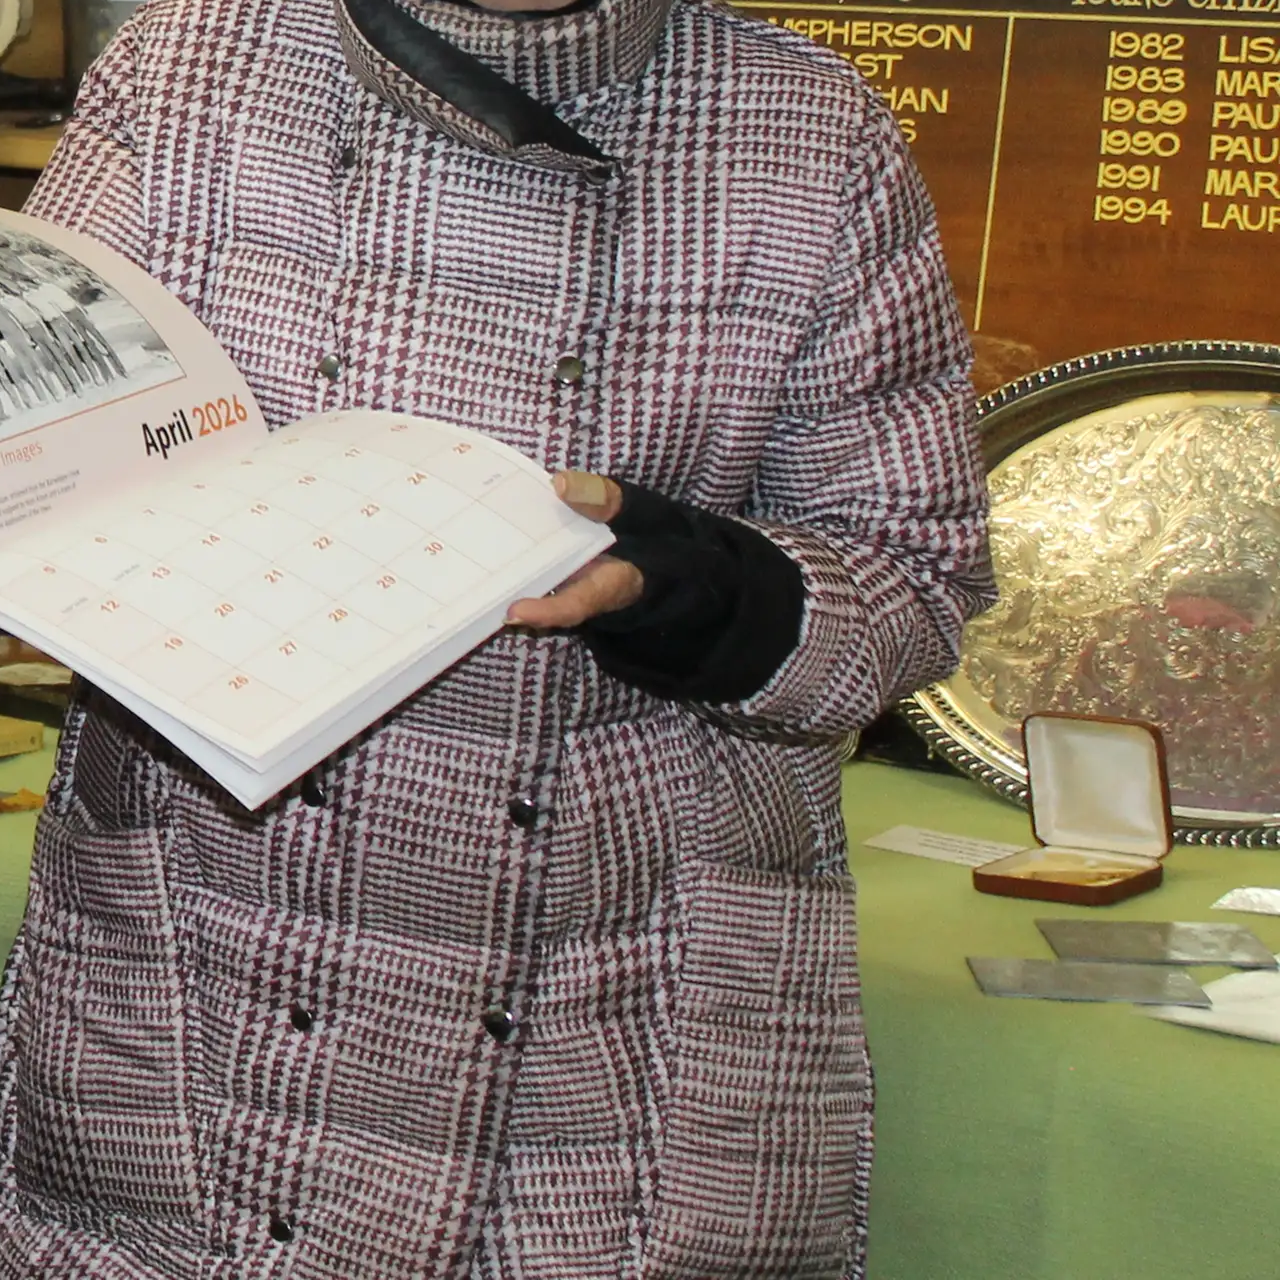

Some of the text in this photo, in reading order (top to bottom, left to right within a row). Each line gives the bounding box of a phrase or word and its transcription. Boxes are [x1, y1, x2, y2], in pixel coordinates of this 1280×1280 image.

[1109, 30, 1184, 61] 1982
[840, 52, 904, 79] ST
[1105, 65, 1280, 98] 1983 MAR
[1102, 96, 1187, 125] 1989
[1099, 128, 1181, 157] 1990
[1097, 162, 1161, 192] 1991
[1093, 194, 1172, 226] 1994
[141, 393, 248, 460] April 2026
[0, 440, 43, 466] Images
[101, 599, 120, 613] 12
[152, 566, 171, 580] 13
[202, 534, 221, 547] 14
[250, 503, 269, 516] 15
[453, 442, 472, 456] 25
[214, 602, 234, 617] 20
[264, 568, 284, 584] 21
[313, 535, 334, 550] 22
[360, 503, 380, 517] 23
[406, 471, 427, 486] 24
[229, 541, 444, 690] 26 27 28 29 30
